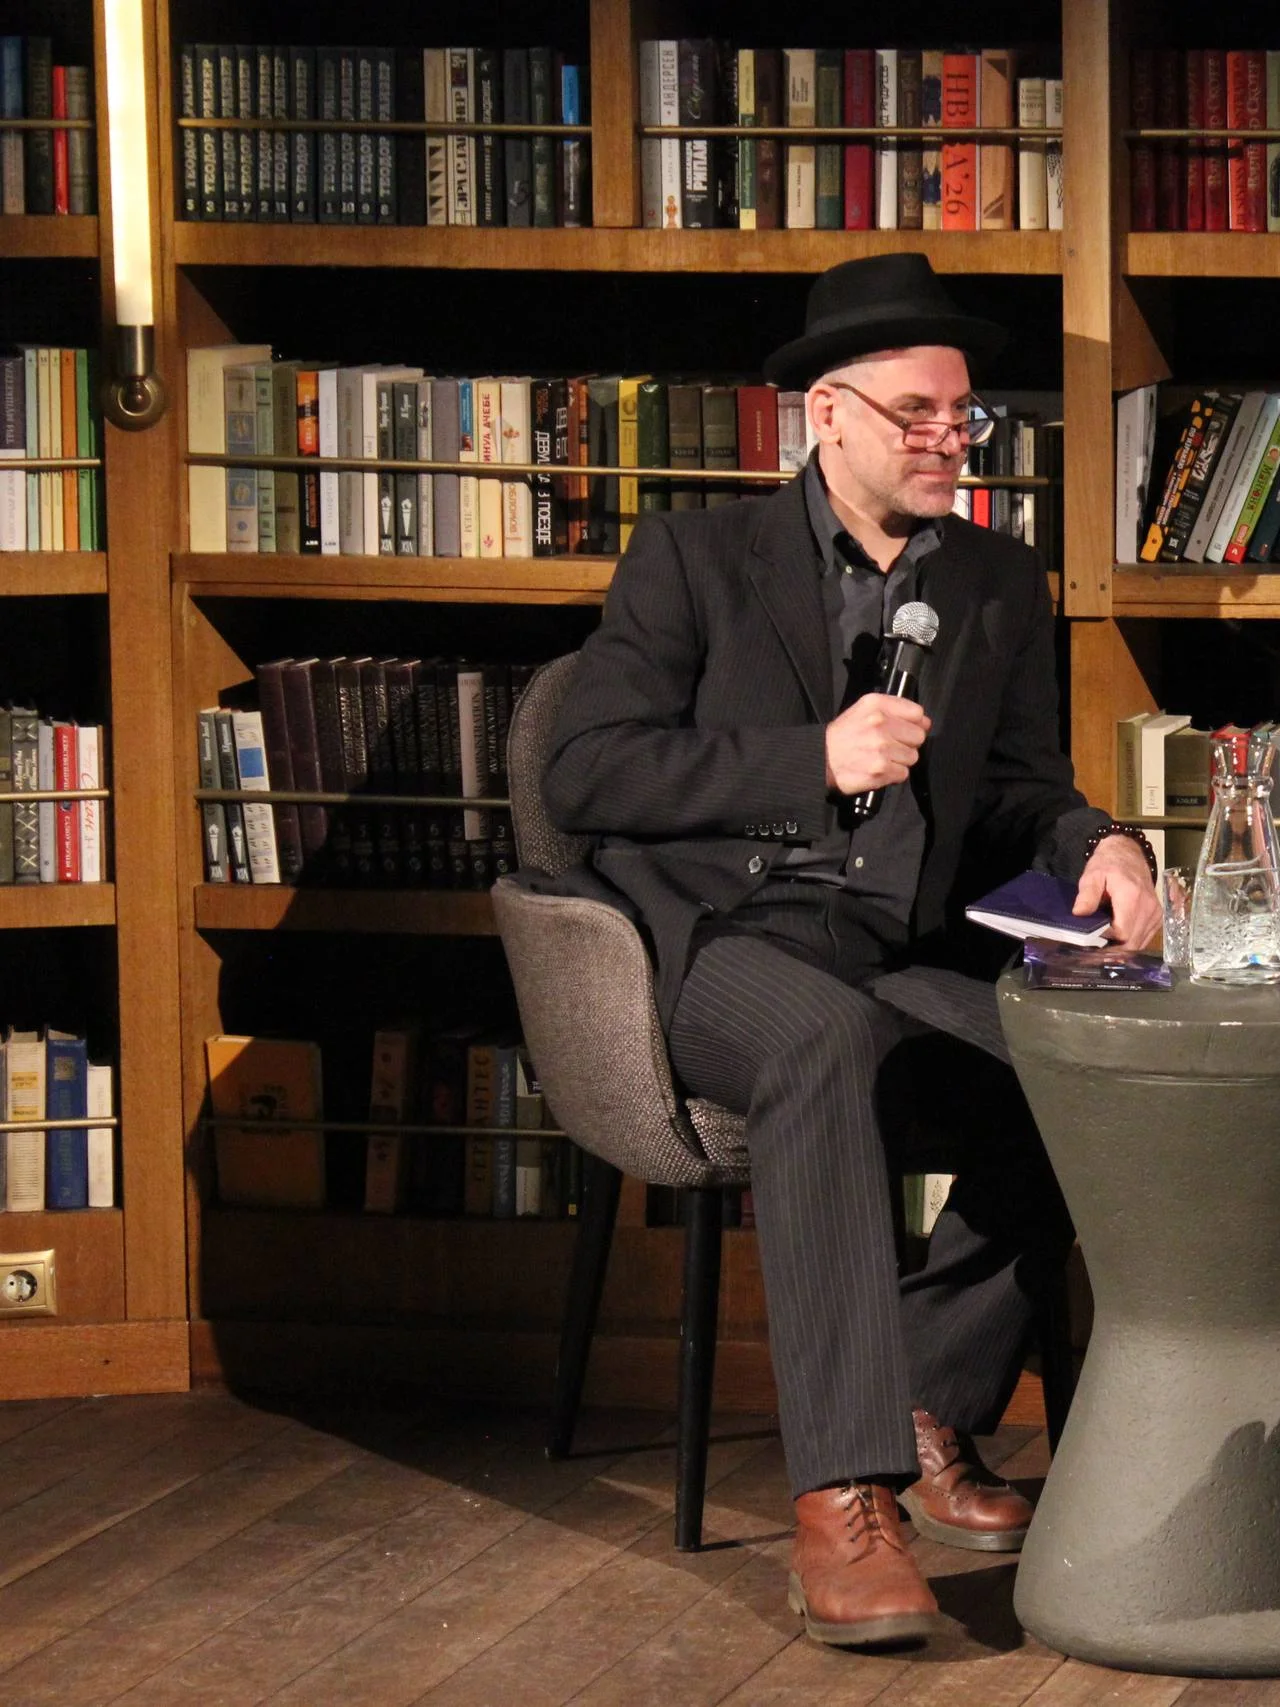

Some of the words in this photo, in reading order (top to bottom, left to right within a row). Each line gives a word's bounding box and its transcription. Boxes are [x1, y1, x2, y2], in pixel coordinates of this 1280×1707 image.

[661, 49, 678, 107] АНДЕРСЕН
[206, 201, 214, 212] 3
[225, 202, 238, 212] 12
[261, 201, 268, 212] 2
[275, 202, 287, 214] 11
[326, 202, 333, 213] 1
[342, 202, 355, 213] 10
[4, 360, 14, 421] МУШКЕТЕРА
[481, 392, 490, 428] АЧЕБЕ
[482, 432, 491, 461] ИНУА
[534, 430, 550, 484] ДЕВУКА
[508, 483, 516, 533] ОБЛОМОВ
[534, 501, 550, 544] ПОЕЗДЕ
[430, 823, 439, 835] 6
[496, 825, 505, 837] 3
